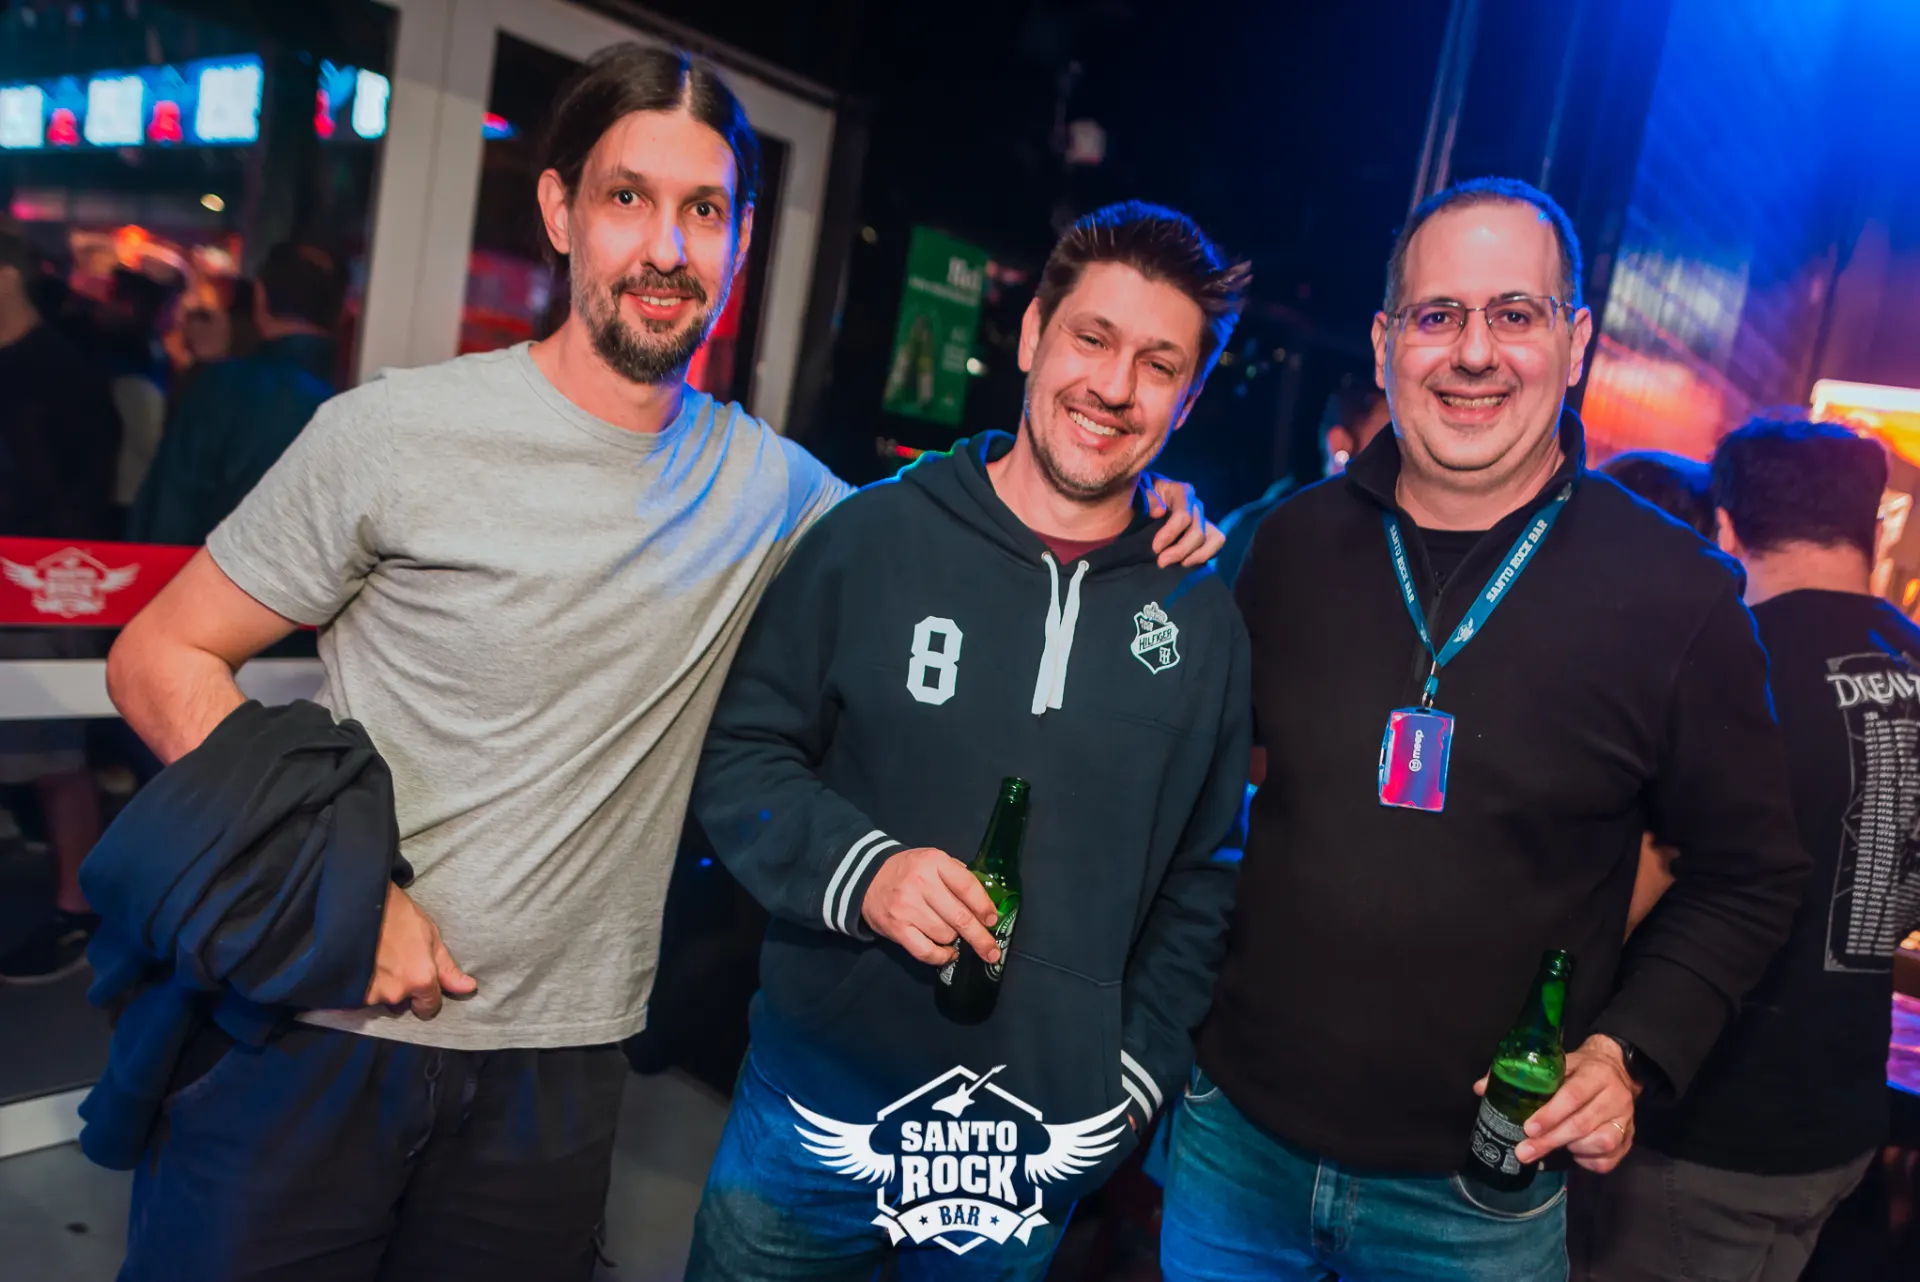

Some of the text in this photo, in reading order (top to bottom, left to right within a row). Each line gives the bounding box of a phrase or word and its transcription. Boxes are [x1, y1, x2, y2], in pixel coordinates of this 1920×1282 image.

[1389, 524, 1415, 604] SANTO ROCK BAR
[1486, 519, 1548, 603] SANTO ROCK BAR
[906, 615, 963, 705] 8
[1139, 628, 1173, 651] HILFIGER
[1412, 729, 1425, 759] meep
